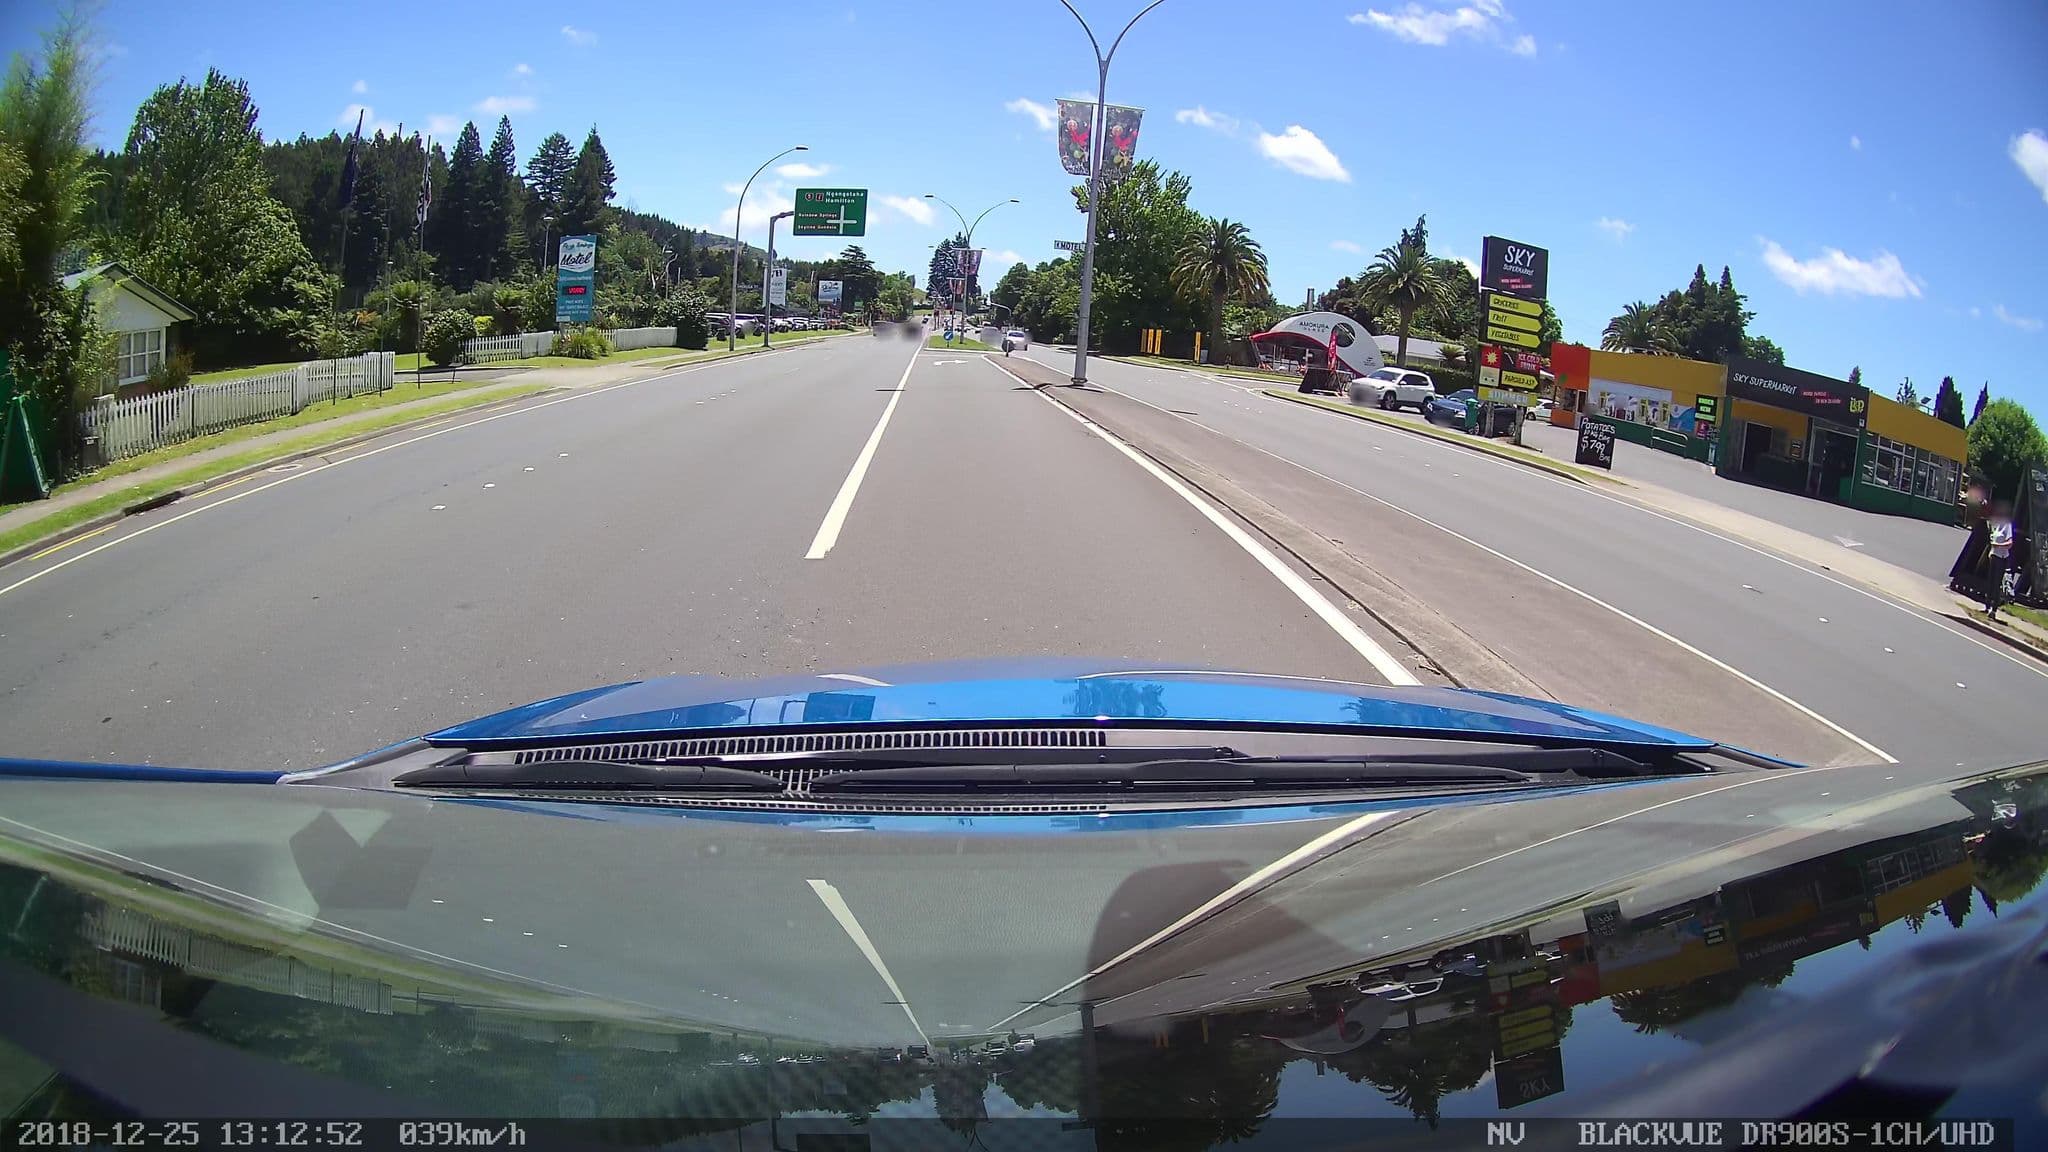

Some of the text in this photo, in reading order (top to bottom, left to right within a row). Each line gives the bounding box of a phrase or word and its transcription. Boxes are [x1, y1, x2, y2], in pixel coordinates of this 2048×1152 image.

[560, 251, 593, 267] Motel
[1504, 245, 1536, 268] SKY
[1733, 372, 1798, 396] SKY SUPERMARKET
[1580, 417, 1616, 434] POTATOES
